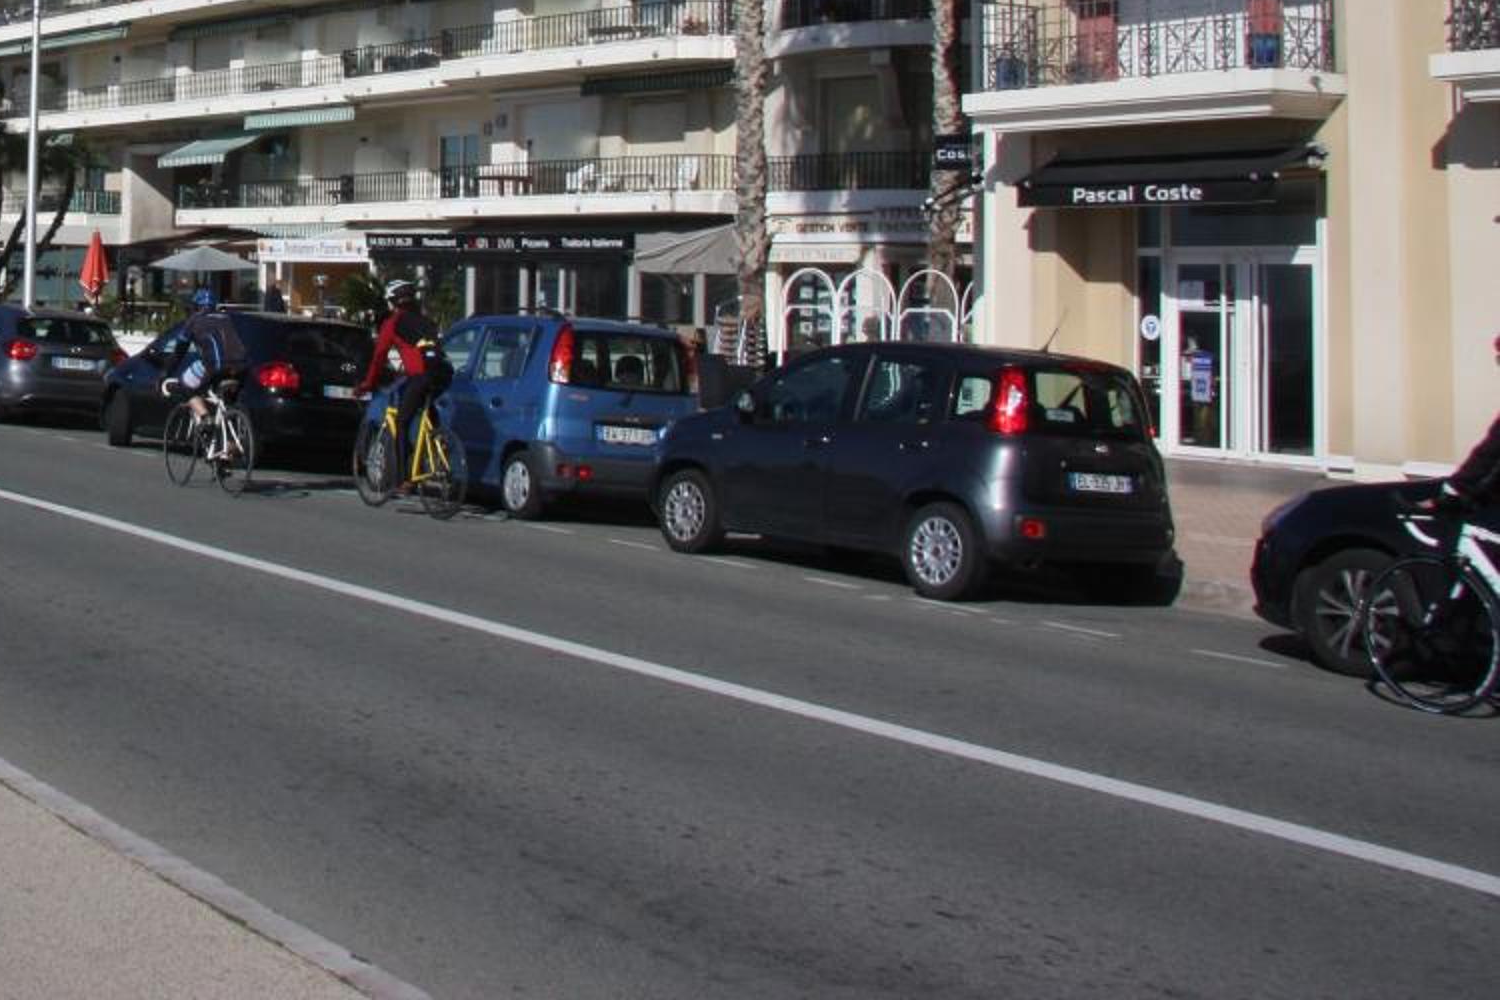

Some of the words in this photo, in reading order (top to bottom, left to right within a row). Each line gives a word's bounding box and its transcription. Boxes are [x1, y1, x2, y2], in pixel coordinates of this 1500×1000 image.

[936, 149, 972, 159] Cos
[1072, 185, 1134, 203] Pascal
[1144, 183, 1203, 201] Coste
